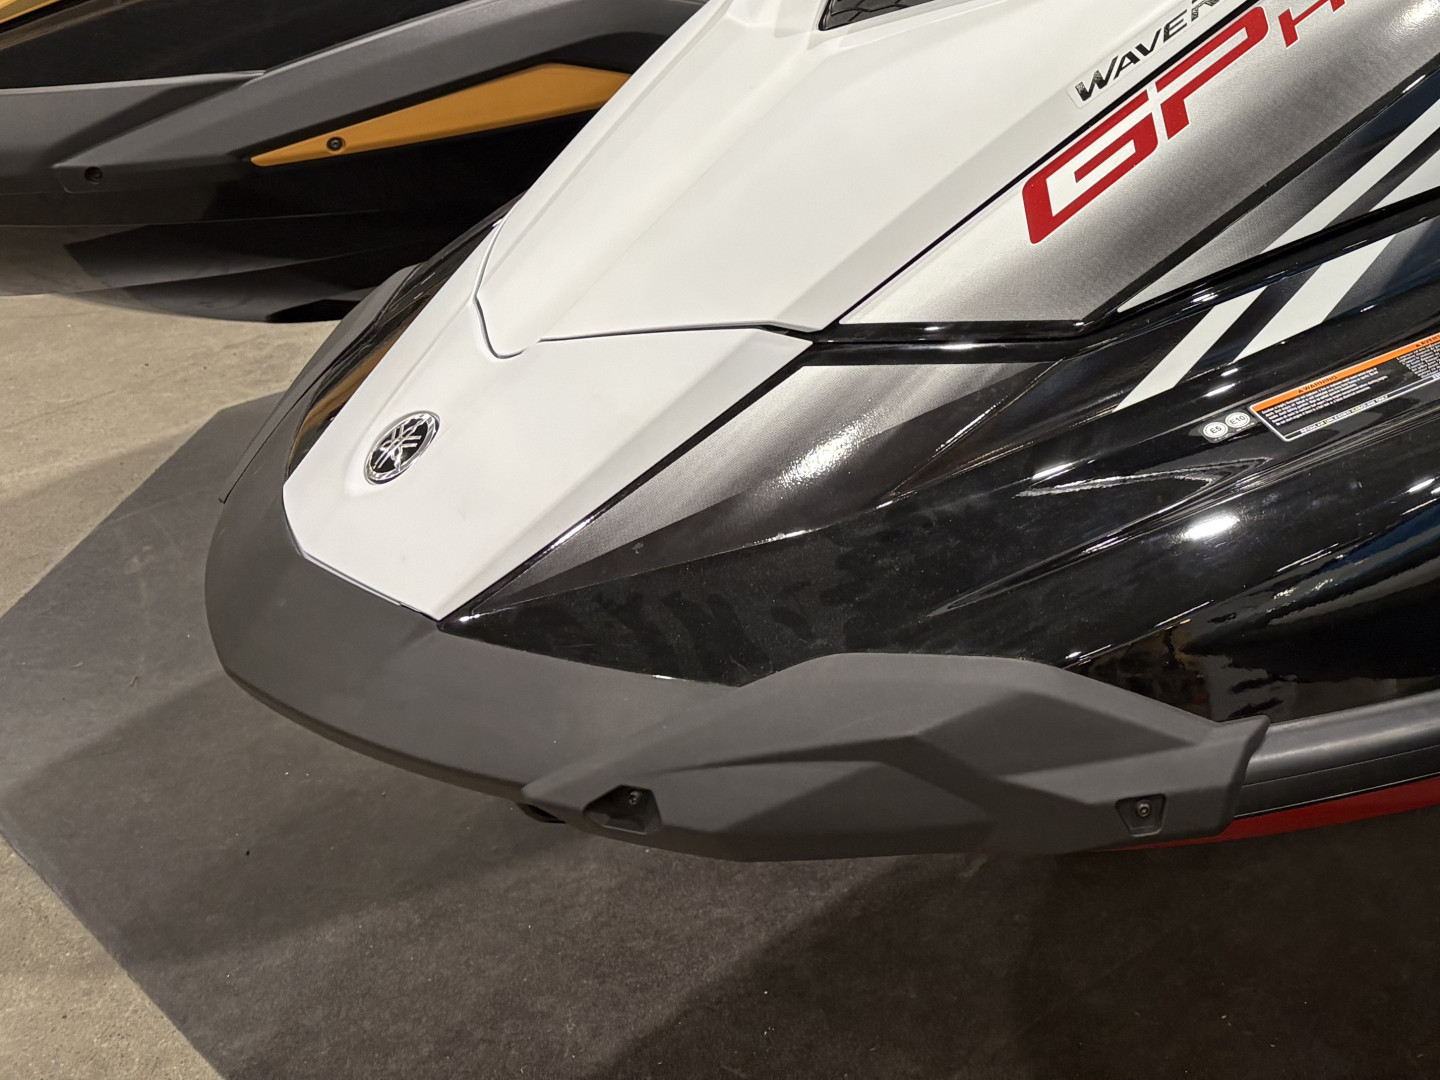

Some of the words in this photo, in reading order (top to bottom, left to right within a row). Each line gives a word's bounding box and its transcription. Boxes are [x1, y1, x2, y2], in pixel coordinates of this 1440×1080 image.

[1303, 375, 1338, 392] WARNING
[1229, 414, 1245, 426] E10
[1210, 425, 1223, 435] E5
